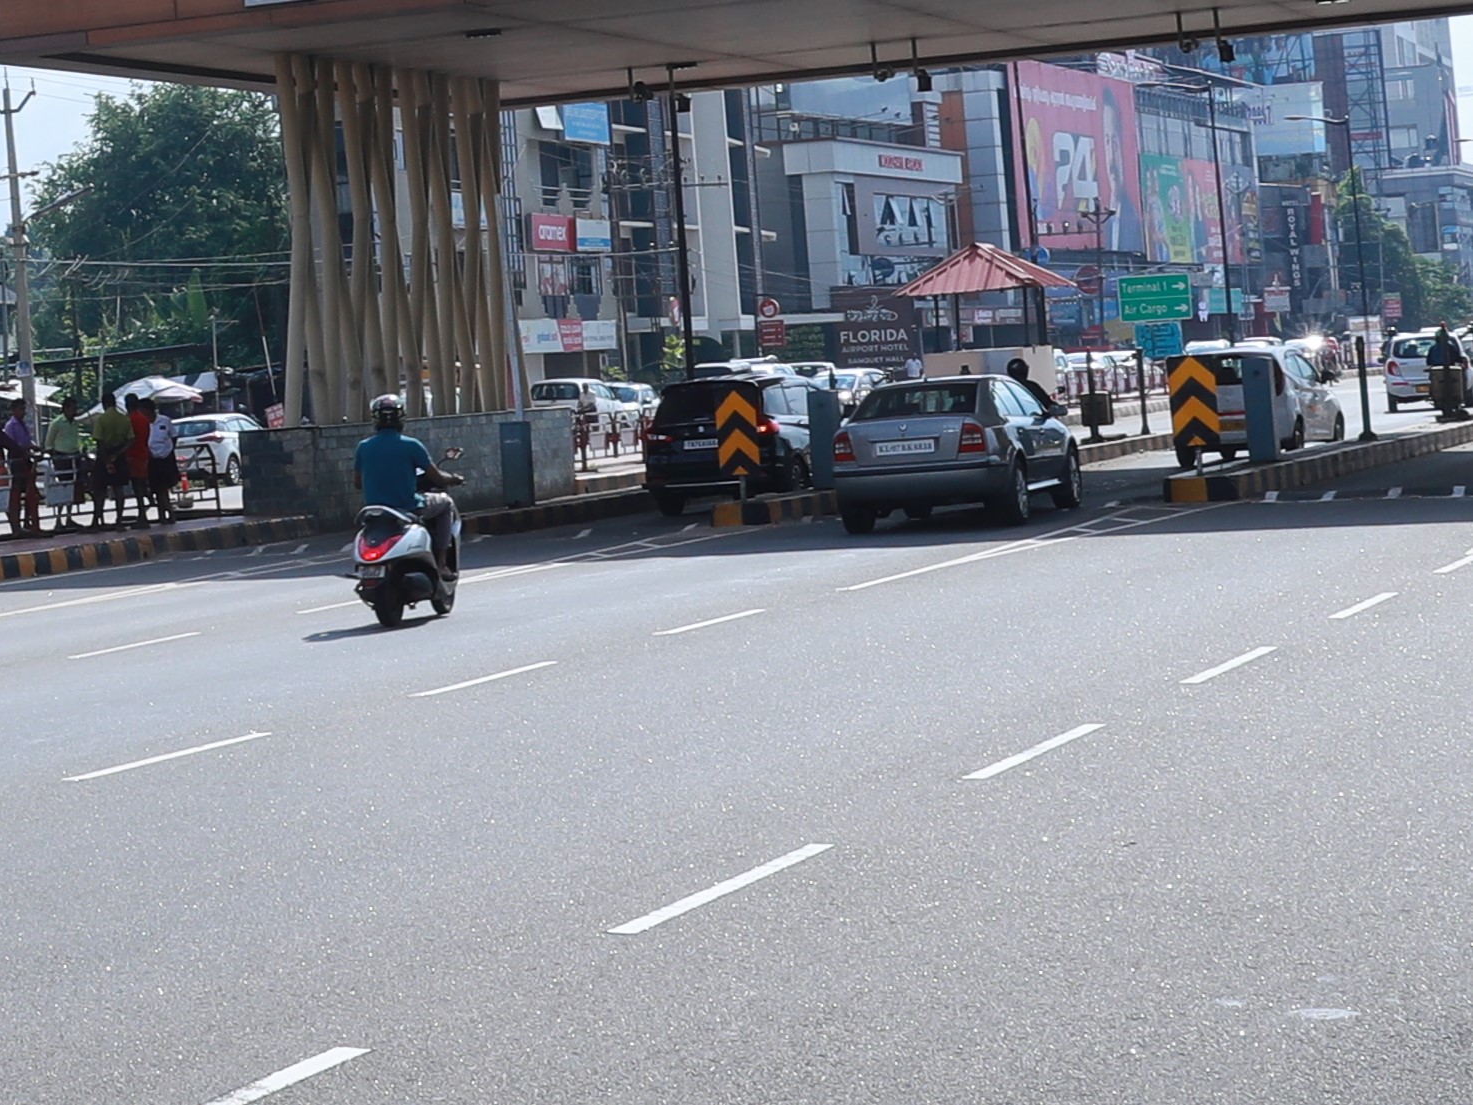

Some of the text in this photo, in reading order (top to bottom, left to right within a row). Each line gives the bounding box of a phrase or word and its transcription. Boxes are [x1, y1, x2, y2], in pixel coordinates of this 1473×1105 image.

[1053, 132, 1099, 212] 24
[538, 224, 568, 241] aramex
[1287, 207, 1298, 246] ROYAL
[1289, 248, 1301, 287] WINGS
[1122, 282, 1161, 293] Terminal
[1124, 303, 1168, 315] Air Cargo
[840, 328, 909, 344] FLORIDA
[880, 343, 909, 352] HOTEL
